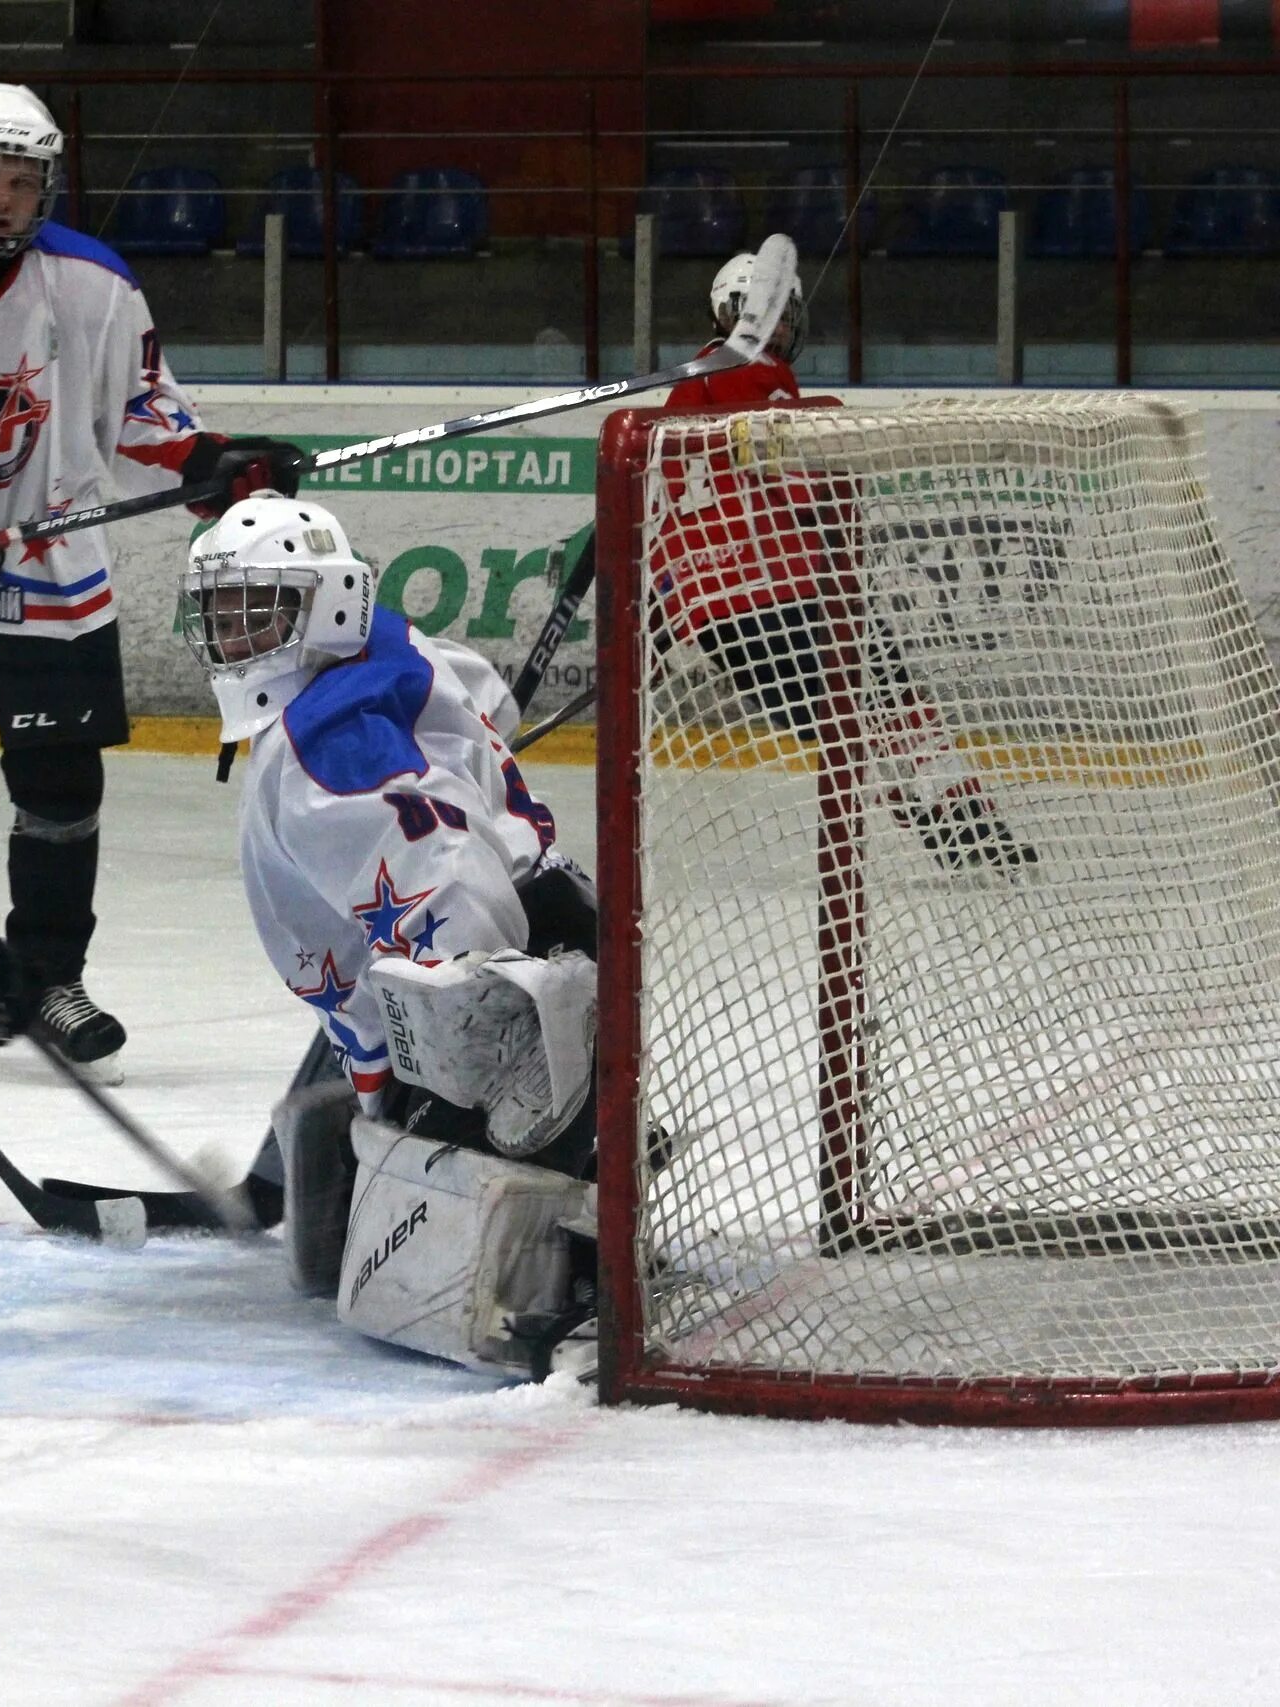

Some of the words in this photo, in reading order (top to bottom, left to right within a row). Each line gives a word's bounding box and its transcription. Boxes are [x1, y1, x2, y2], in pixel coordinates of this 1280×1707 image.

[193, 550, 237, 566] BAUER
[359, 572, 371, 638] BAUER
[382, 987, 415, 1073] BAUER
[349, 1200, 429, 1312] BAUER
